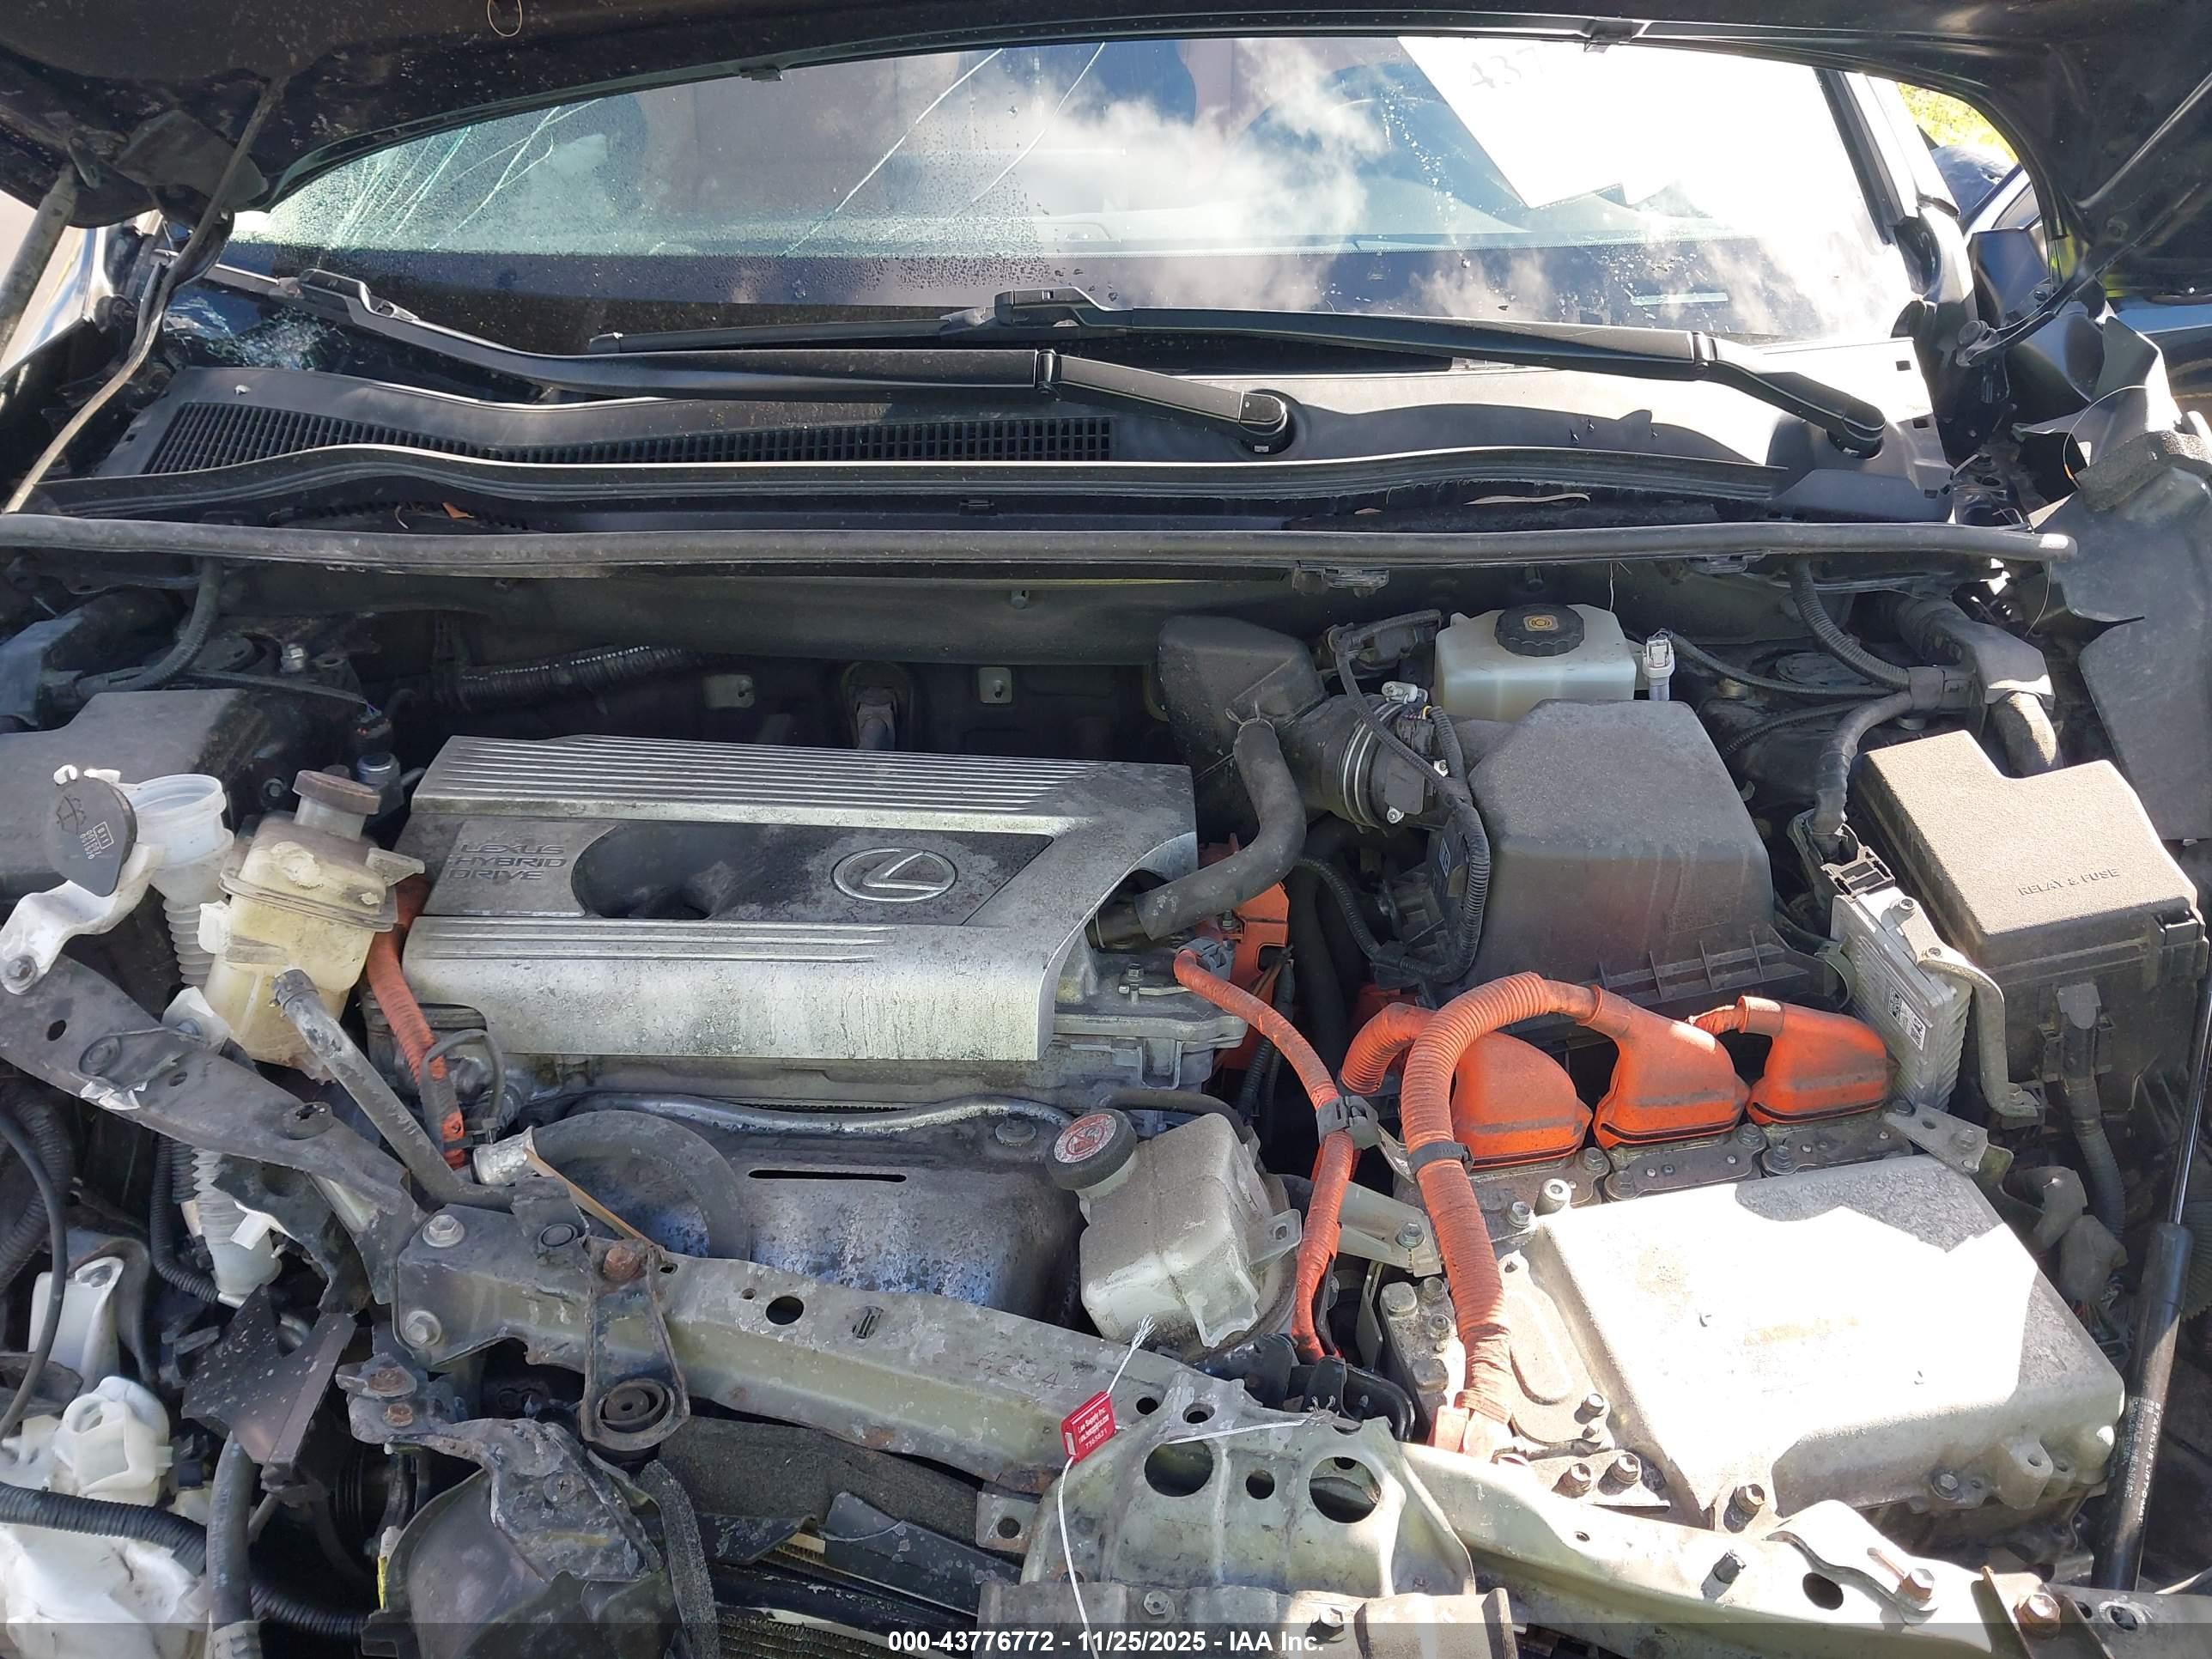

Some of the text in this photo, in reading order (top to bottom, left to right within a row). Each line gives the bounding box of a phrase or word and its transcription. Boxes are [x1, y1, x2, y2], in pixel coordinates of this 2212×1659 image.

[460, 844, 565, 854] LEXUS
[453, 855, 568, 868] HYBRID
[447, 868, 544, 880] DRIVE
[2018, 879, 2064, 896] RELAY
[2081, 869, 2120, 883] FUSE
